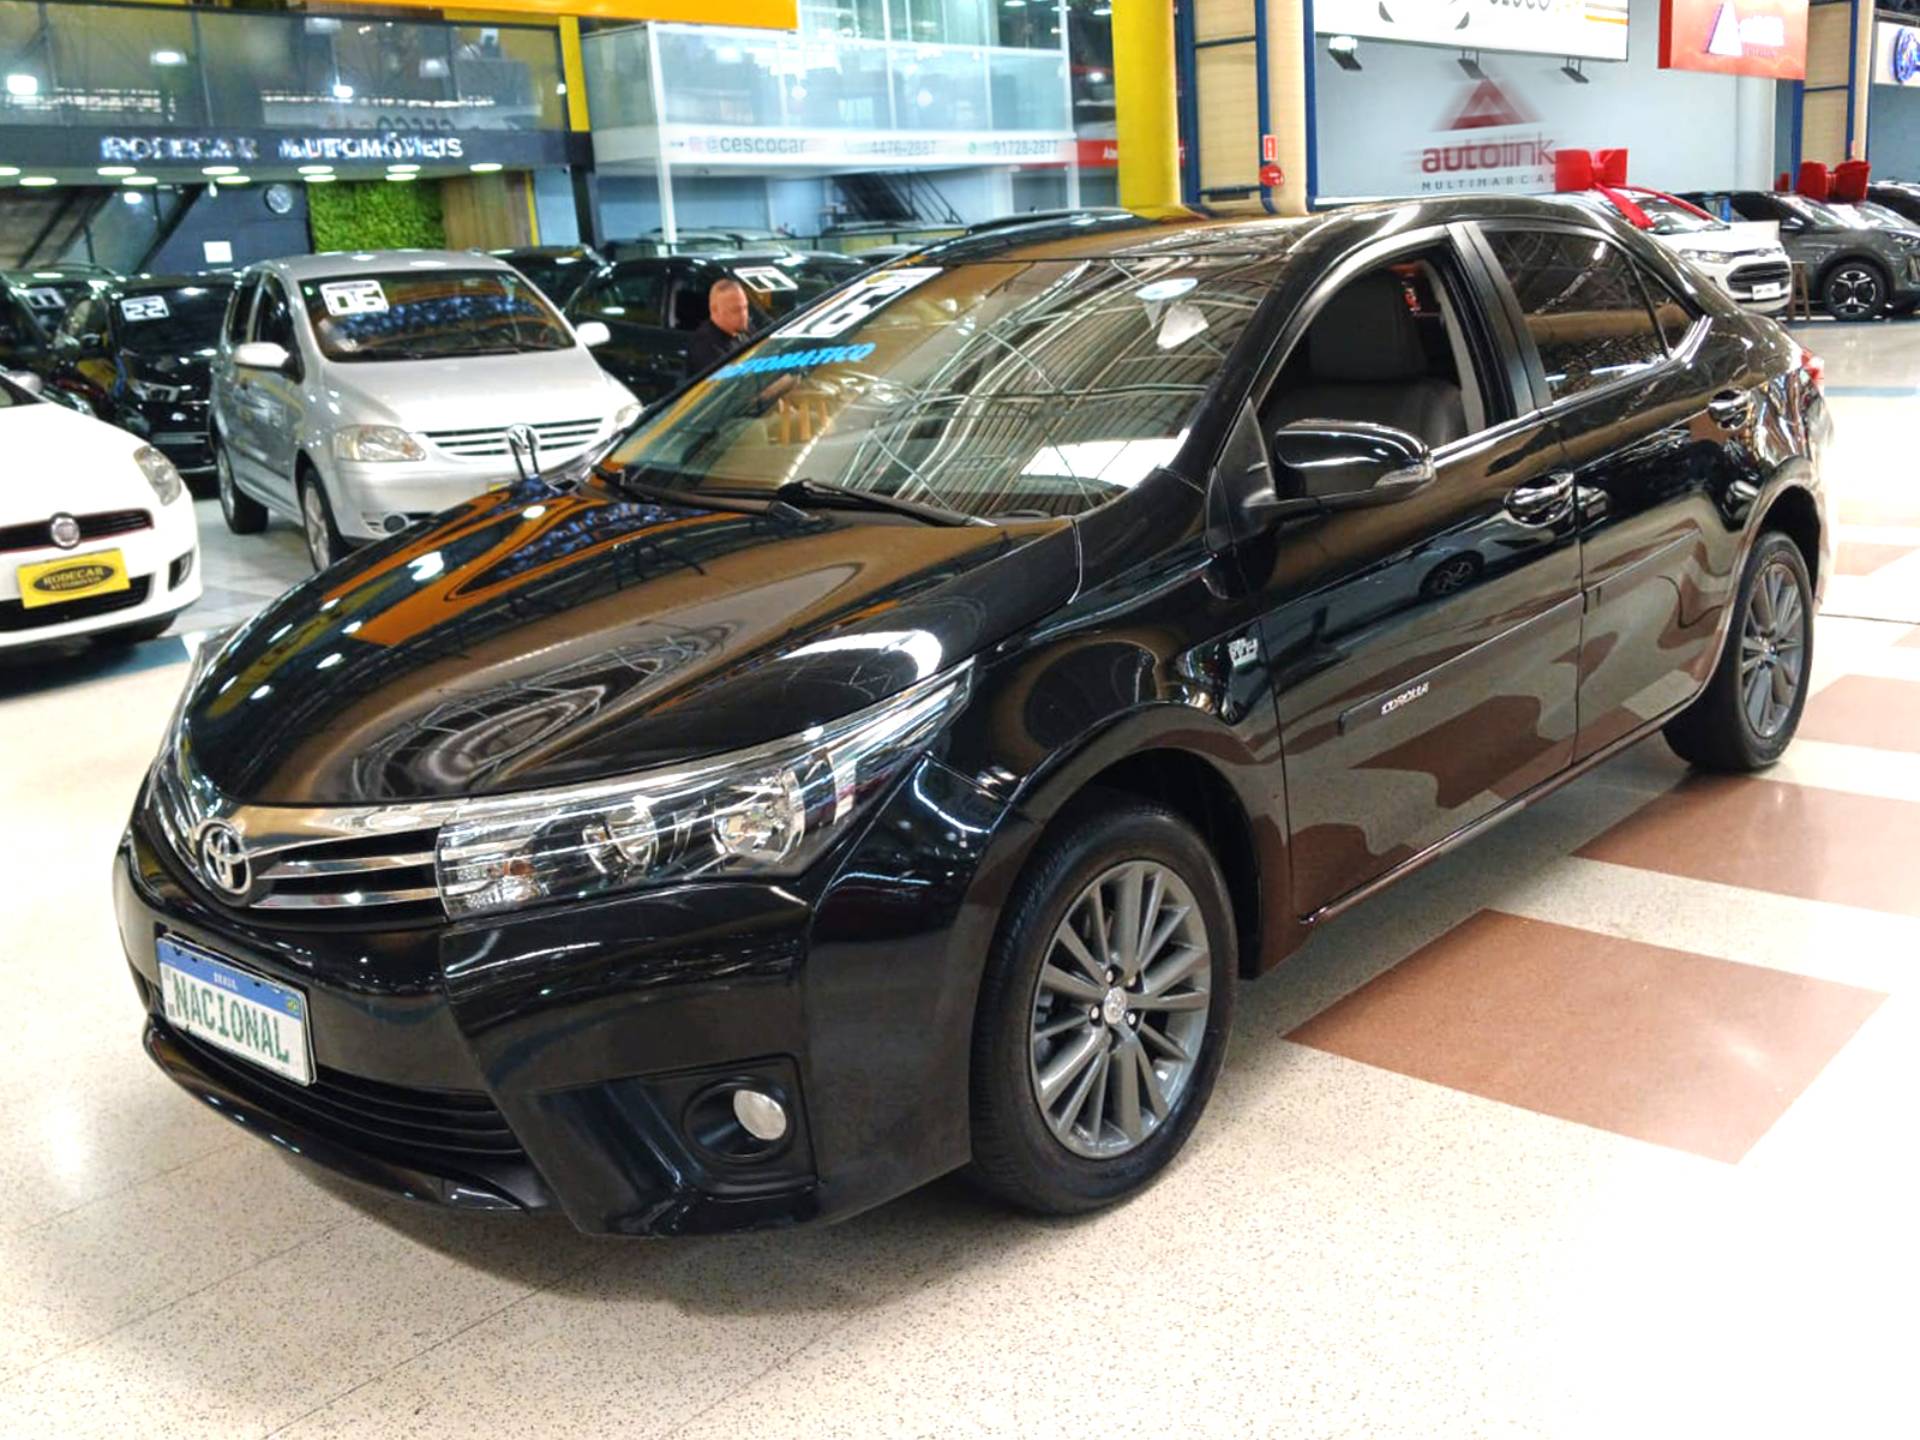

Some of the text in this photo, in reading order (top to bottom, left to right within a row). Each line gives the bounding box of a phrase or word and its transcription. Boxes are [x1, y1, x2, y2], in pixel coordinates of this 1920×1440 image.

[1421, 131, 1557, 174] autolink
[124, 301, 168, 319] 22
[173, 972, 290, 1064] NACIONAL
